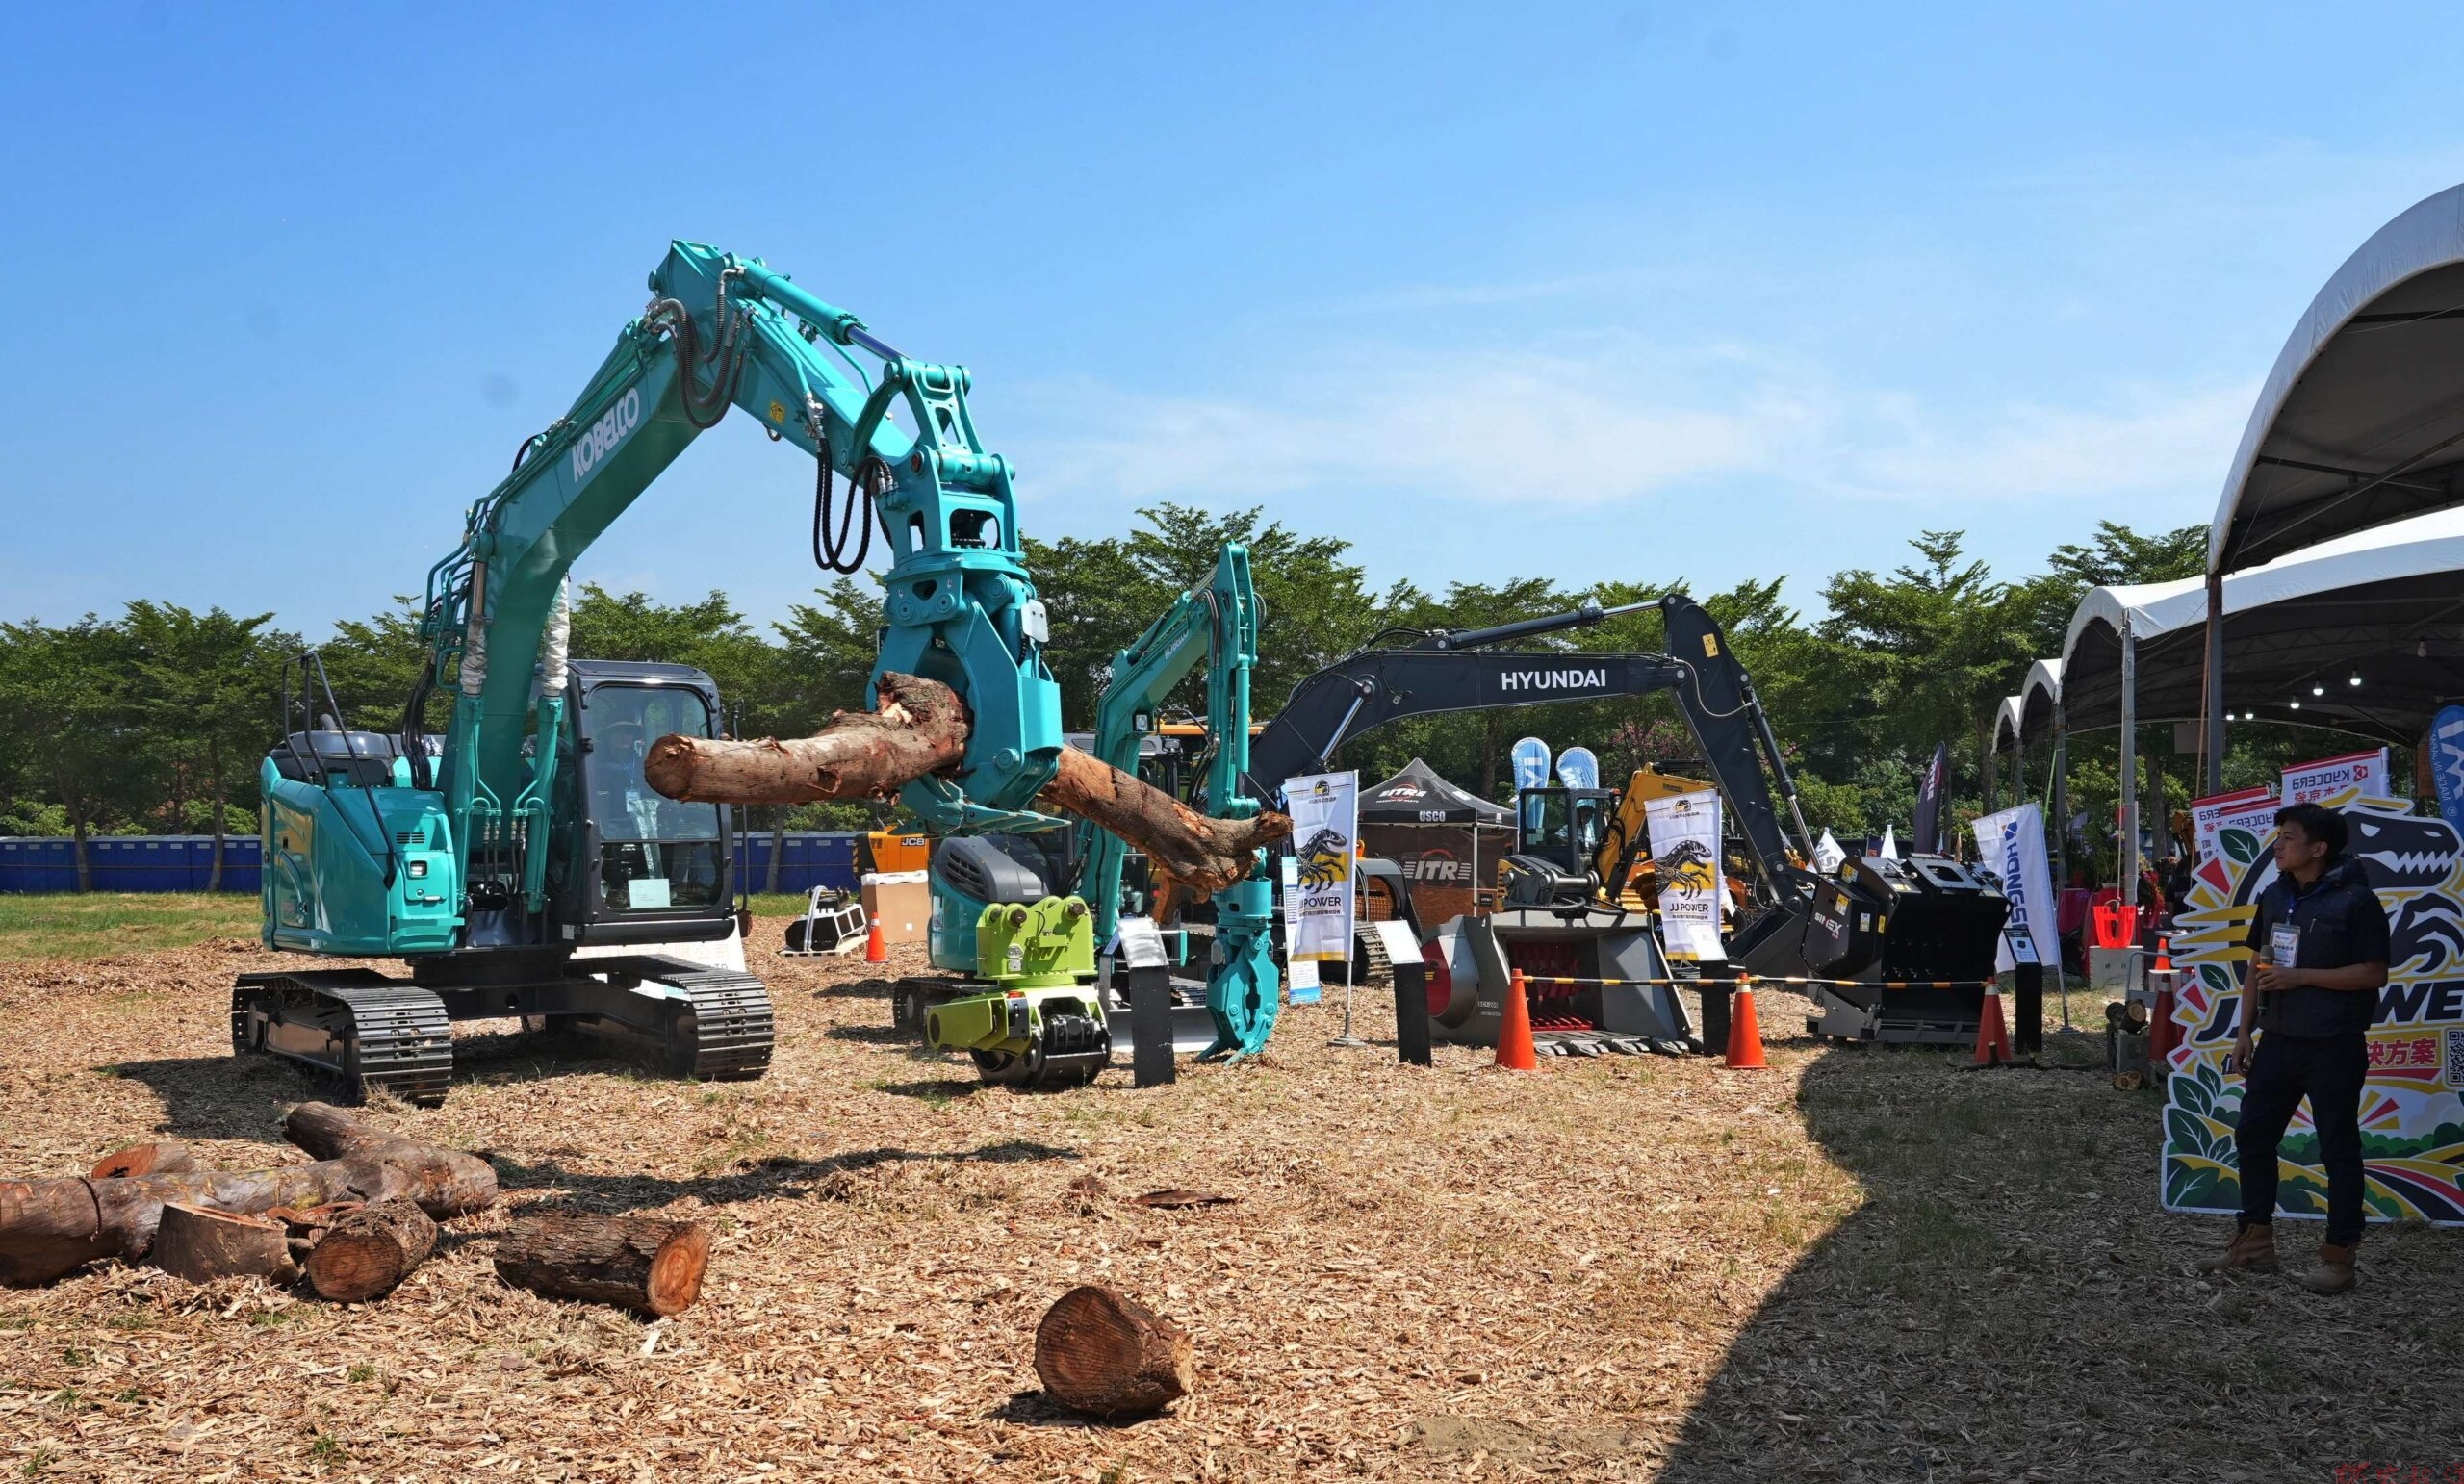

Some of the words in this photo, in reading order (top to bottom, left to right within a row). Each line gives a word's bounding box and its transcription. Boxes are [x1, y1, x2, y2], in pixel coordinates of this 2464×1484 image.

[572, 387, 639, 483] KOBELCO
[1502, 669, 1606, 690] HYUNDAI
[1419, 810, 1446, 822] USCO
[901, 837, 925, 846] JCB
[1415, 861, 1458, 880] ITR
[1303, 896, 1342, 908] POWER
[1669, 903, 1679, 912] JJ
[1681, 903, 1708, 912] POWER
